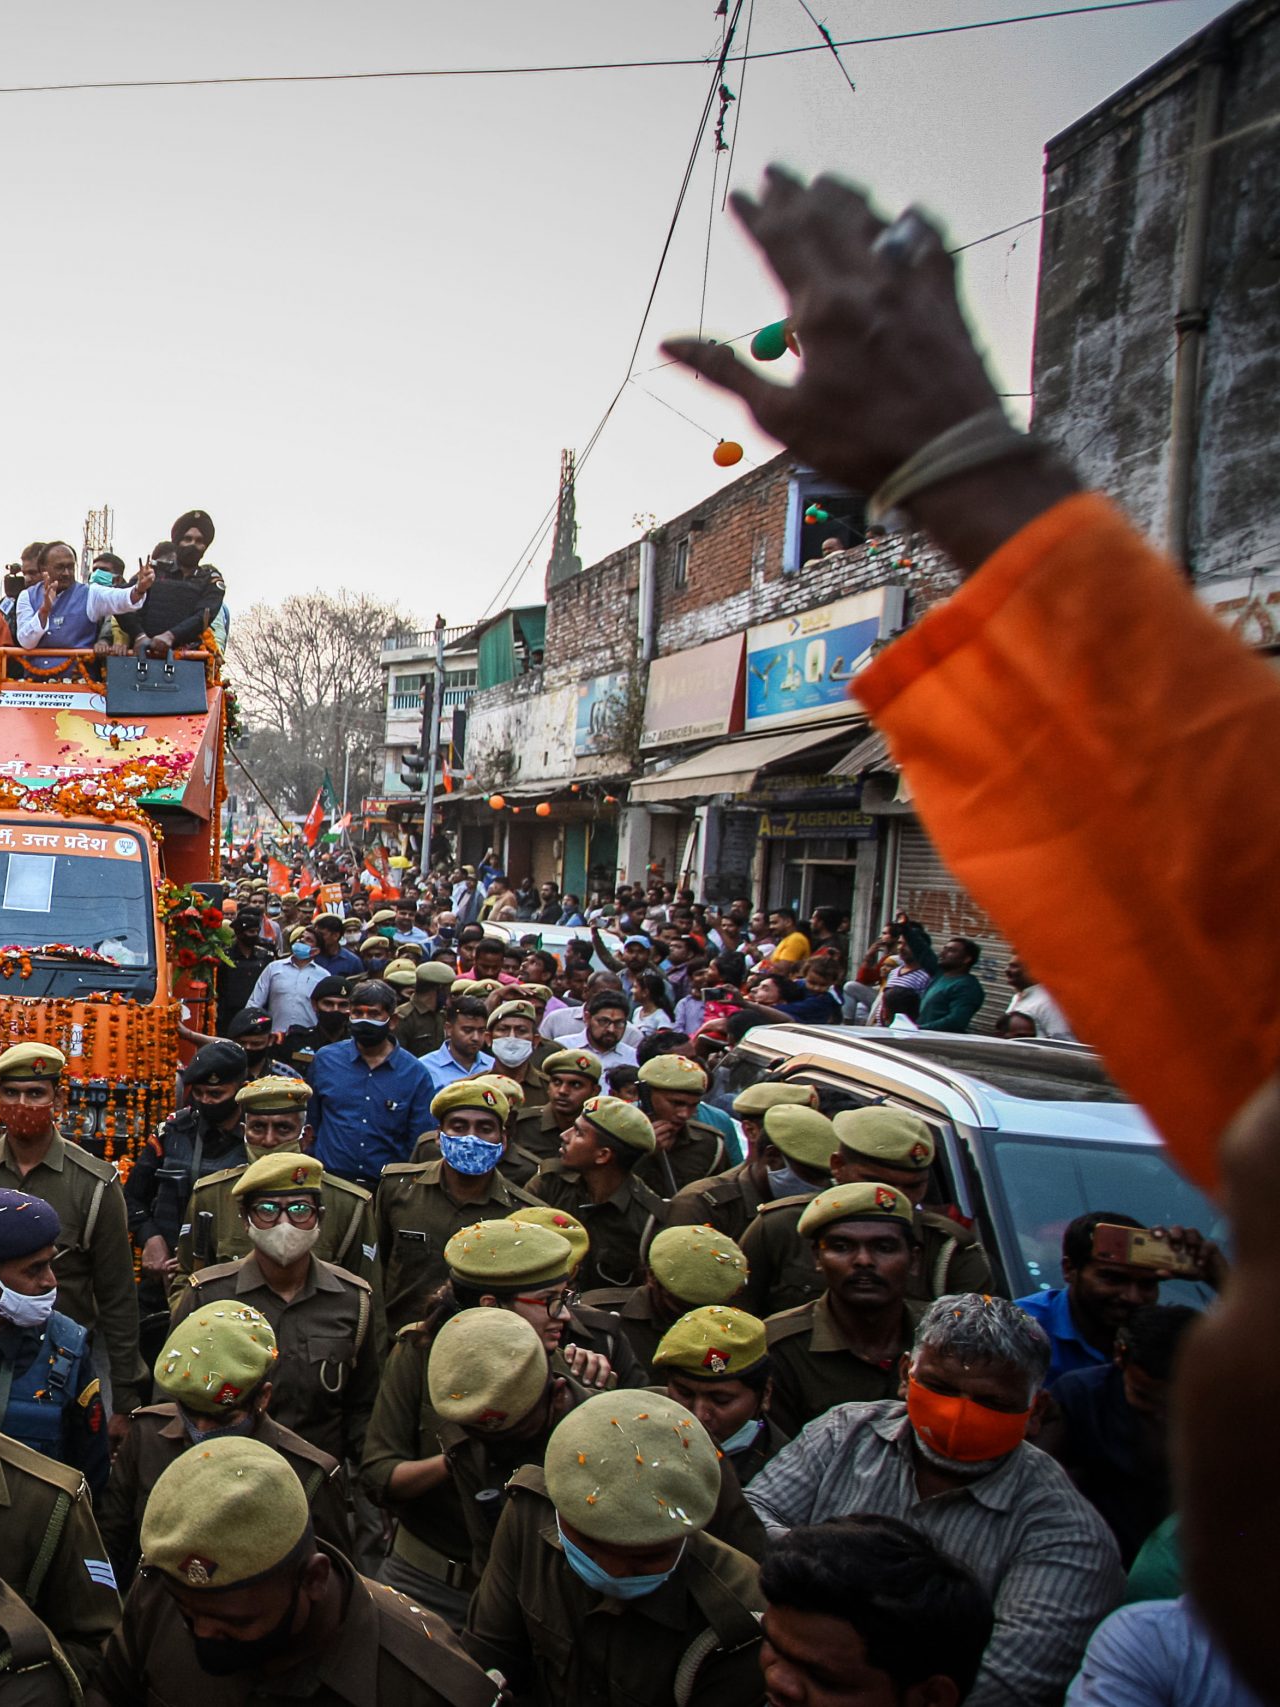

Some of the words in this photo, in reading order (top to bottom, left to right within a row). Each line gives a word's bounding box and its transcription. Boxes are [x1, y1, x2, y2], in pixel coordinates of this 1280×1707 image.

[658, 725, 693, 741] AGENCIES
[798, 811, 874, 826] AGENCIES
[22, 832, 60, 848] उत्तर
[64, 832, 109, 851] प्रदेश
